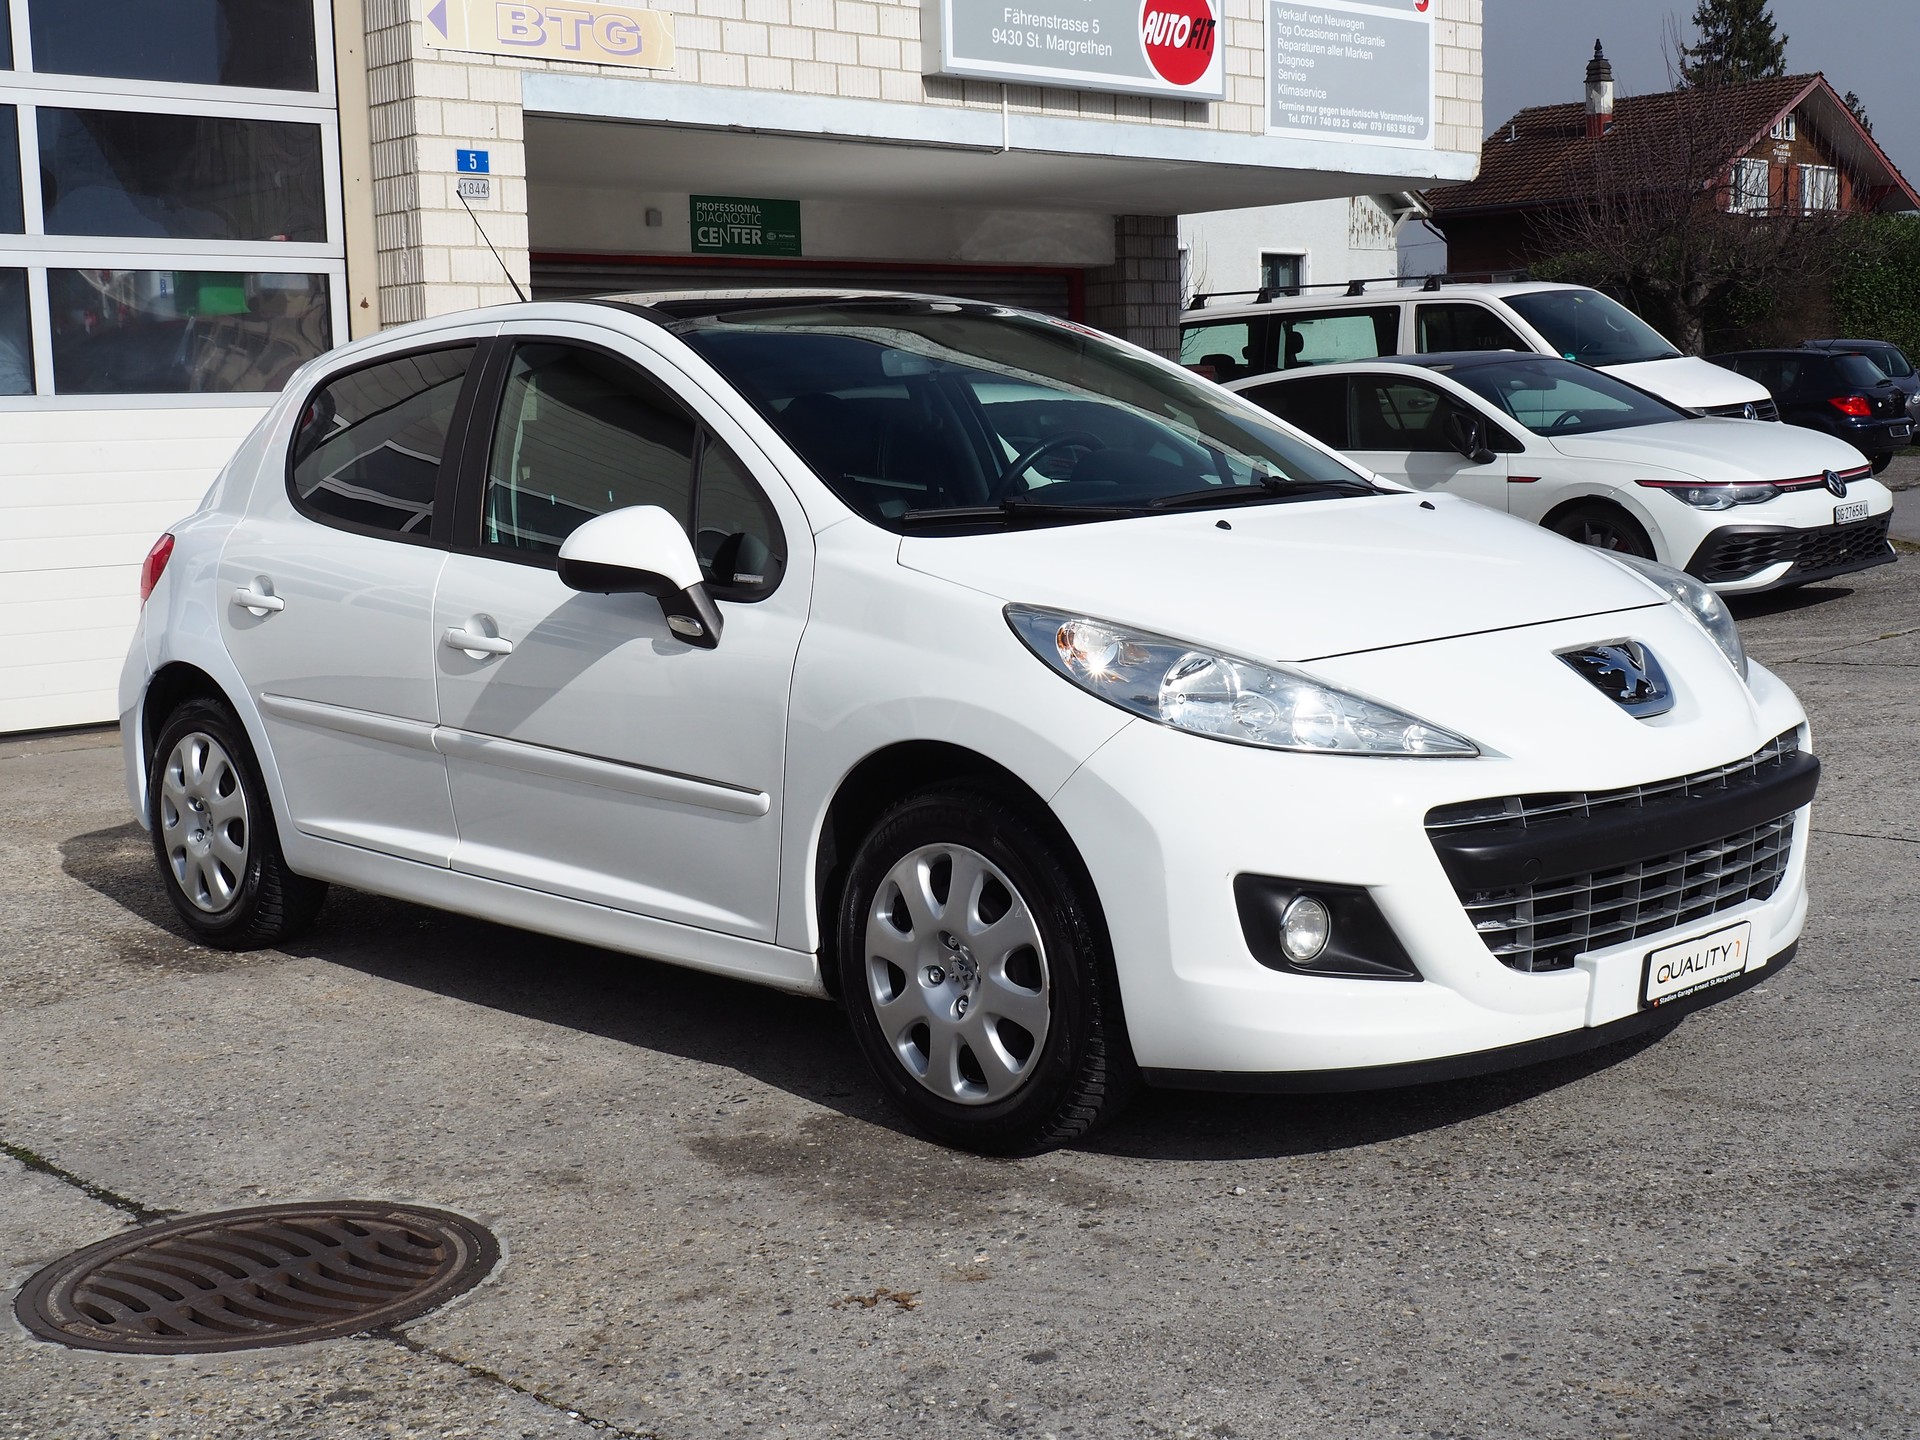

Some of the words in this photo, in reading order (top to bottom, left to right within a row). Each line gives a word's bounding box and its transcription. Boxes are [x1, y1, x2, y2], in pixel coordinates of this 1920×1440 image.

[496, 2, 643, 56] BTG
[1003, 7, 1089, 32] Fährenstrasse
[1091, 19, 1100, 34] 5
[1277, 7, 1307, 21] Verkauf
[1308, 13, 1323, 25] von
[1324, 14, 1365, 31] Neuwagen
[991, 28, 1023, 47] 9430
[1026, 33, 1043, 50] St.
[1046, 34, 1112, 57] Margrethen
[1277, 22, 1292, 37] Top
[1294, 24, 1339, 41] Occasionen
[1340, 32, 1352, 43] mit
[1353, 33, 1386, 47] Garantie
[1277, 37, 1326, 54] Reparaturen
[1327, 45, 1344, 57] aller
[1345, 47, 1373, 60] Marken
[1277, 52, 1315, 68] Diagnose
[1277, 68, 1307, 82] Service
[1277, 83, 1327, 100] Klimaservice
[1277, 100, 1305, 112] Termine
[1306, 104, 1318, 114] nur
[1318, 106, 1339, 117] gegen
[1340, 107, 1379, 119] telefonische
[1379, 110, 1424, 126] Voranmeldung
[1288, 113, 1299, 124] Tel.
[1320, 116, 1331, 127] 740
[1332, 117, 1341, 128] 09
[1341, 118, 1350, 129] 25
[1352, 120, 1368, 130] oder
[1398, 123, 1407, 134] 58
[1407, 124, 1416, 135] 62
[469, 153, 477, 170] 5
[463, 182, 486, 195] 1844
[696, 202, 762, 214] PROFESSIONAL
[696, 210, 762, 225] DIAGNOSTIC
[697, 226, 762, 245] CENTER
[1657, 942, 1733, 984] QUALITY
[1660, 994, 1677, 1004] Stadion
[1678, 988, 1693, 998] Garage
